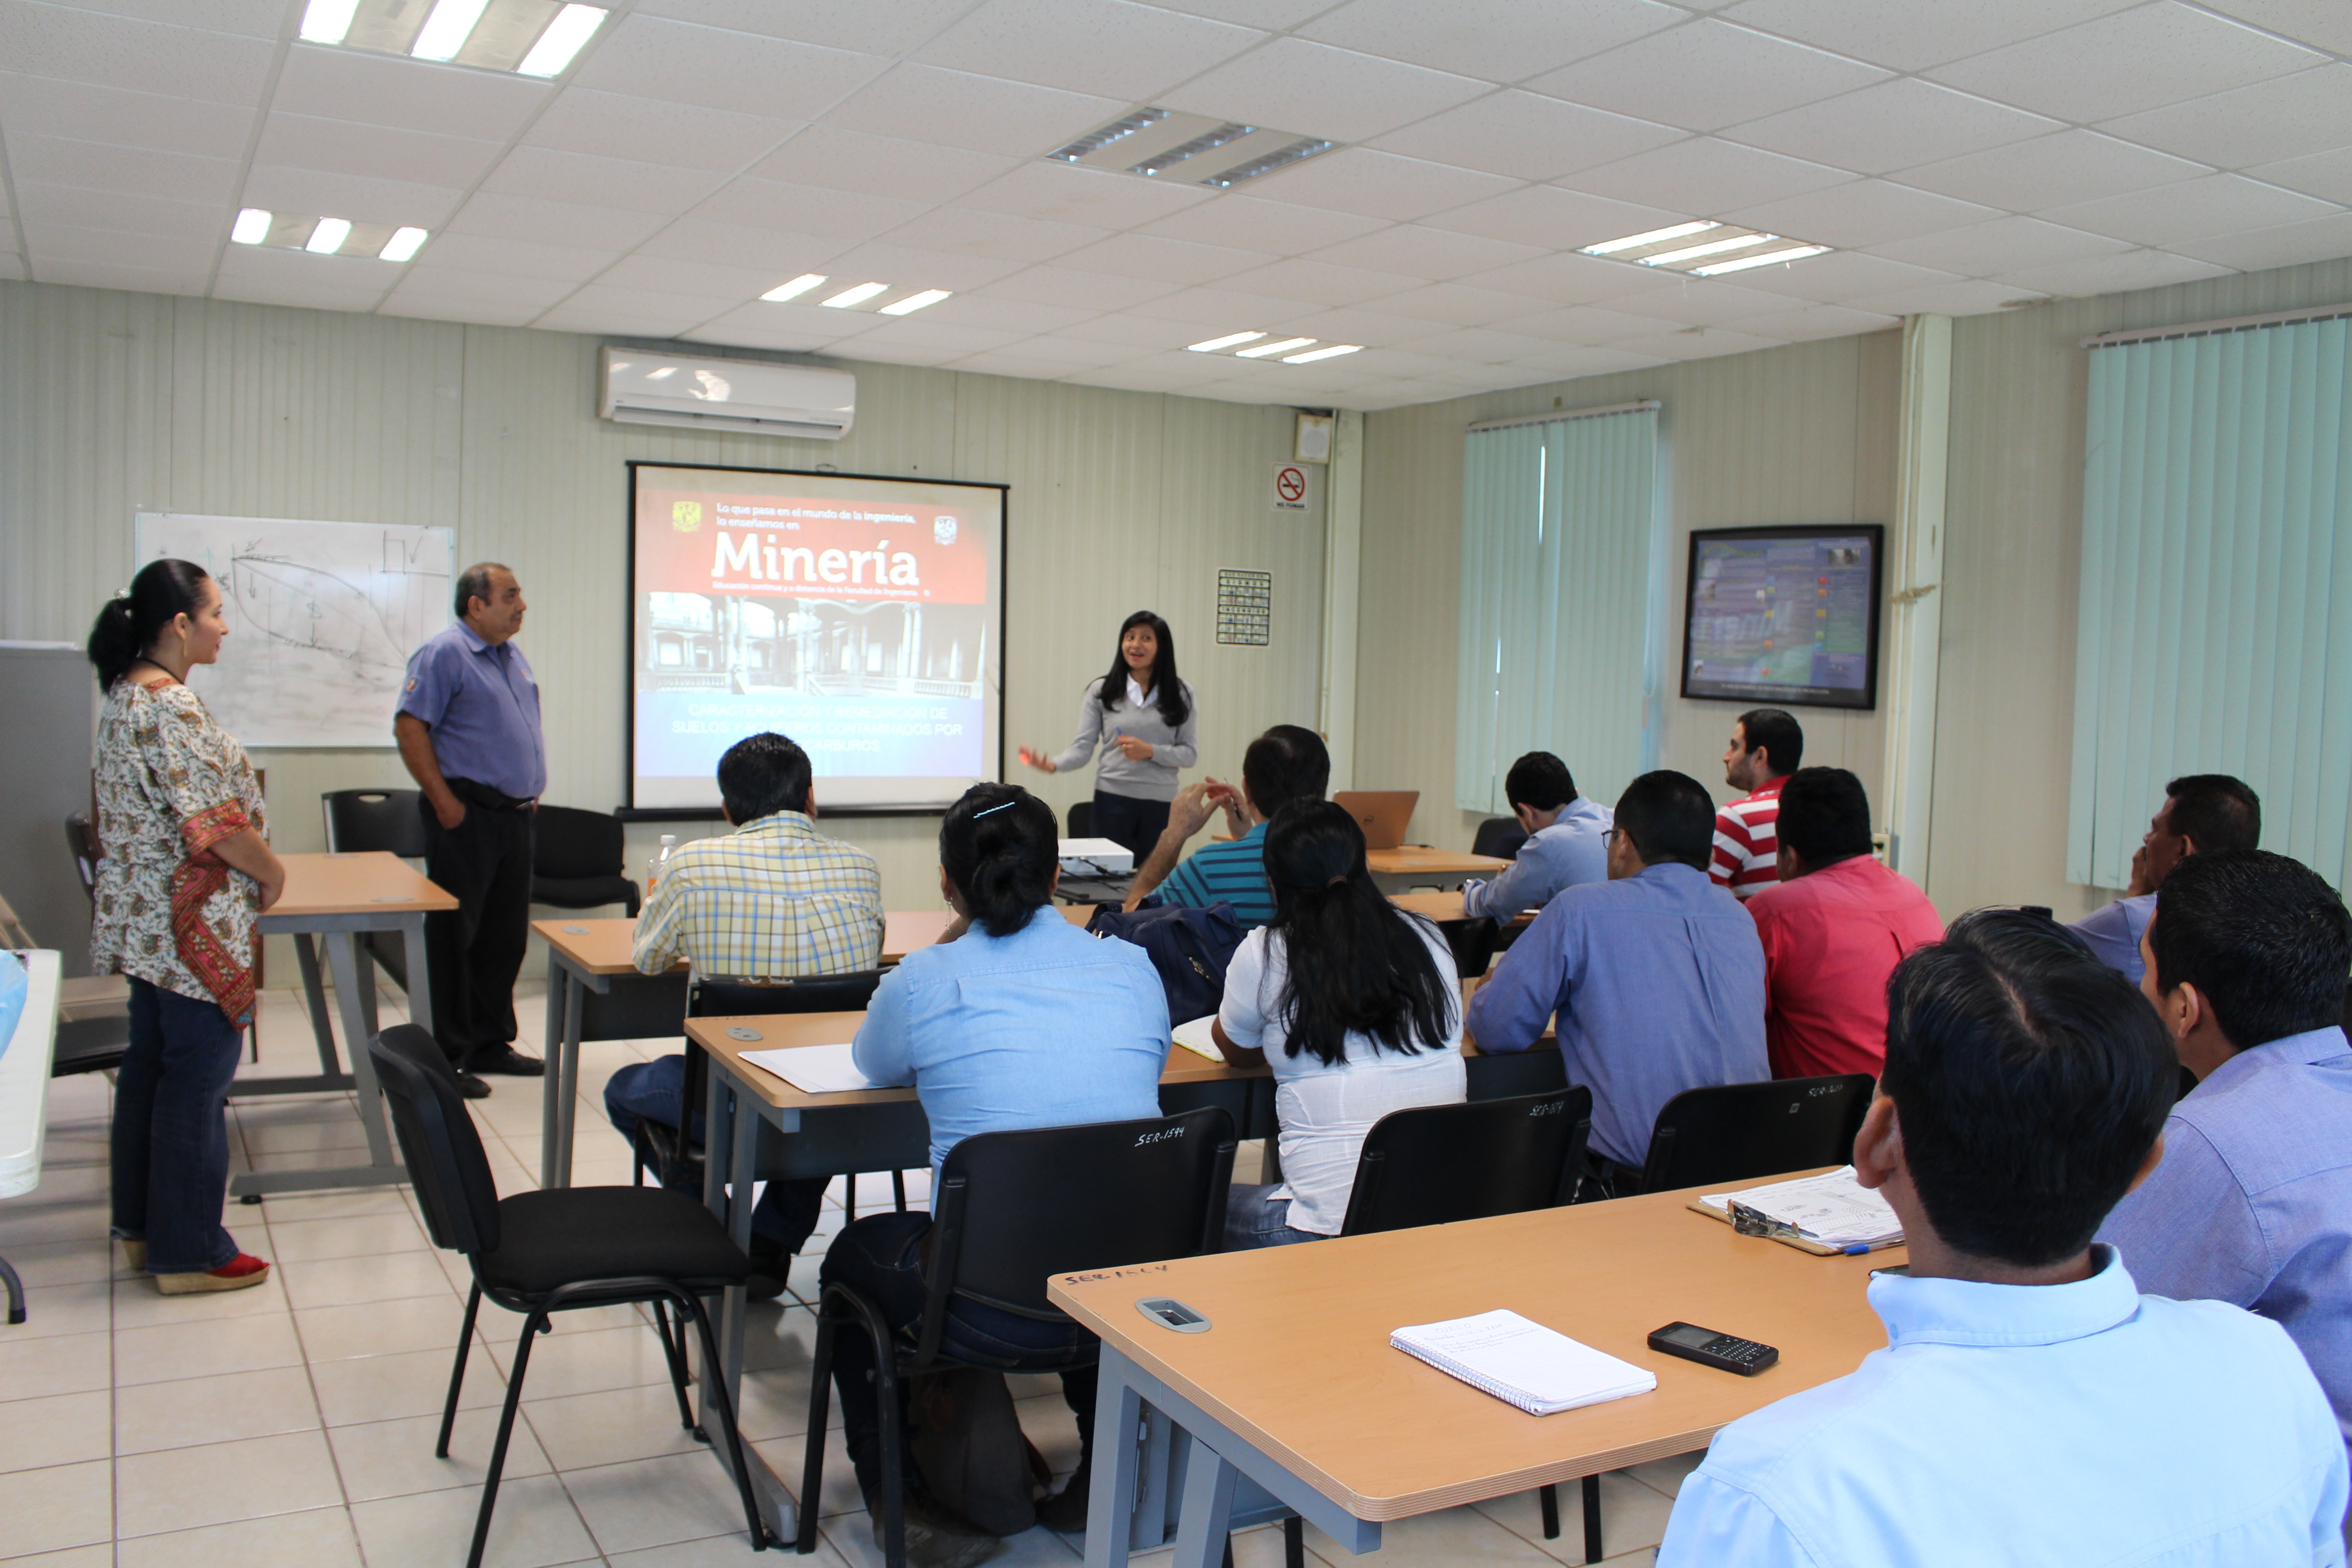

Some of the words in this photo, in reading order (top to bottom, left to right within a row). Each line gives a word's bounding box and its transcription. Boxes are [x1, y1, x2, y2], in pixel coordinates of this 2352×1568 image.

[716, 502, 730, 513] Lo
[731, 505, 751, 515] que
[752, 506, 776, 516] pasa
[776, 507, 790, 516] en
[791, 507, 801, 517] el
[802, 509, 838, 519] mundo
[839, 509, 852, 520] de
[853, 510, 862, 520] la
[716, 515, 727, 526] lo
[728, 517, 785, 529] enseñamos
[786, 521, 800, 530] en
[711, 531, 919, 586] Minería
[822, 706, 832, 717] Y
[930, 707, 948, 720] DE
[671, 720, 729, 734] SUELOS
[732, 721, 741, 733] Y
[826, 722, 932, 736] CONTAMINADOS
[935, 723, 962, 736] POR
[1135, 1127, 1185, 1147] SER-1594
